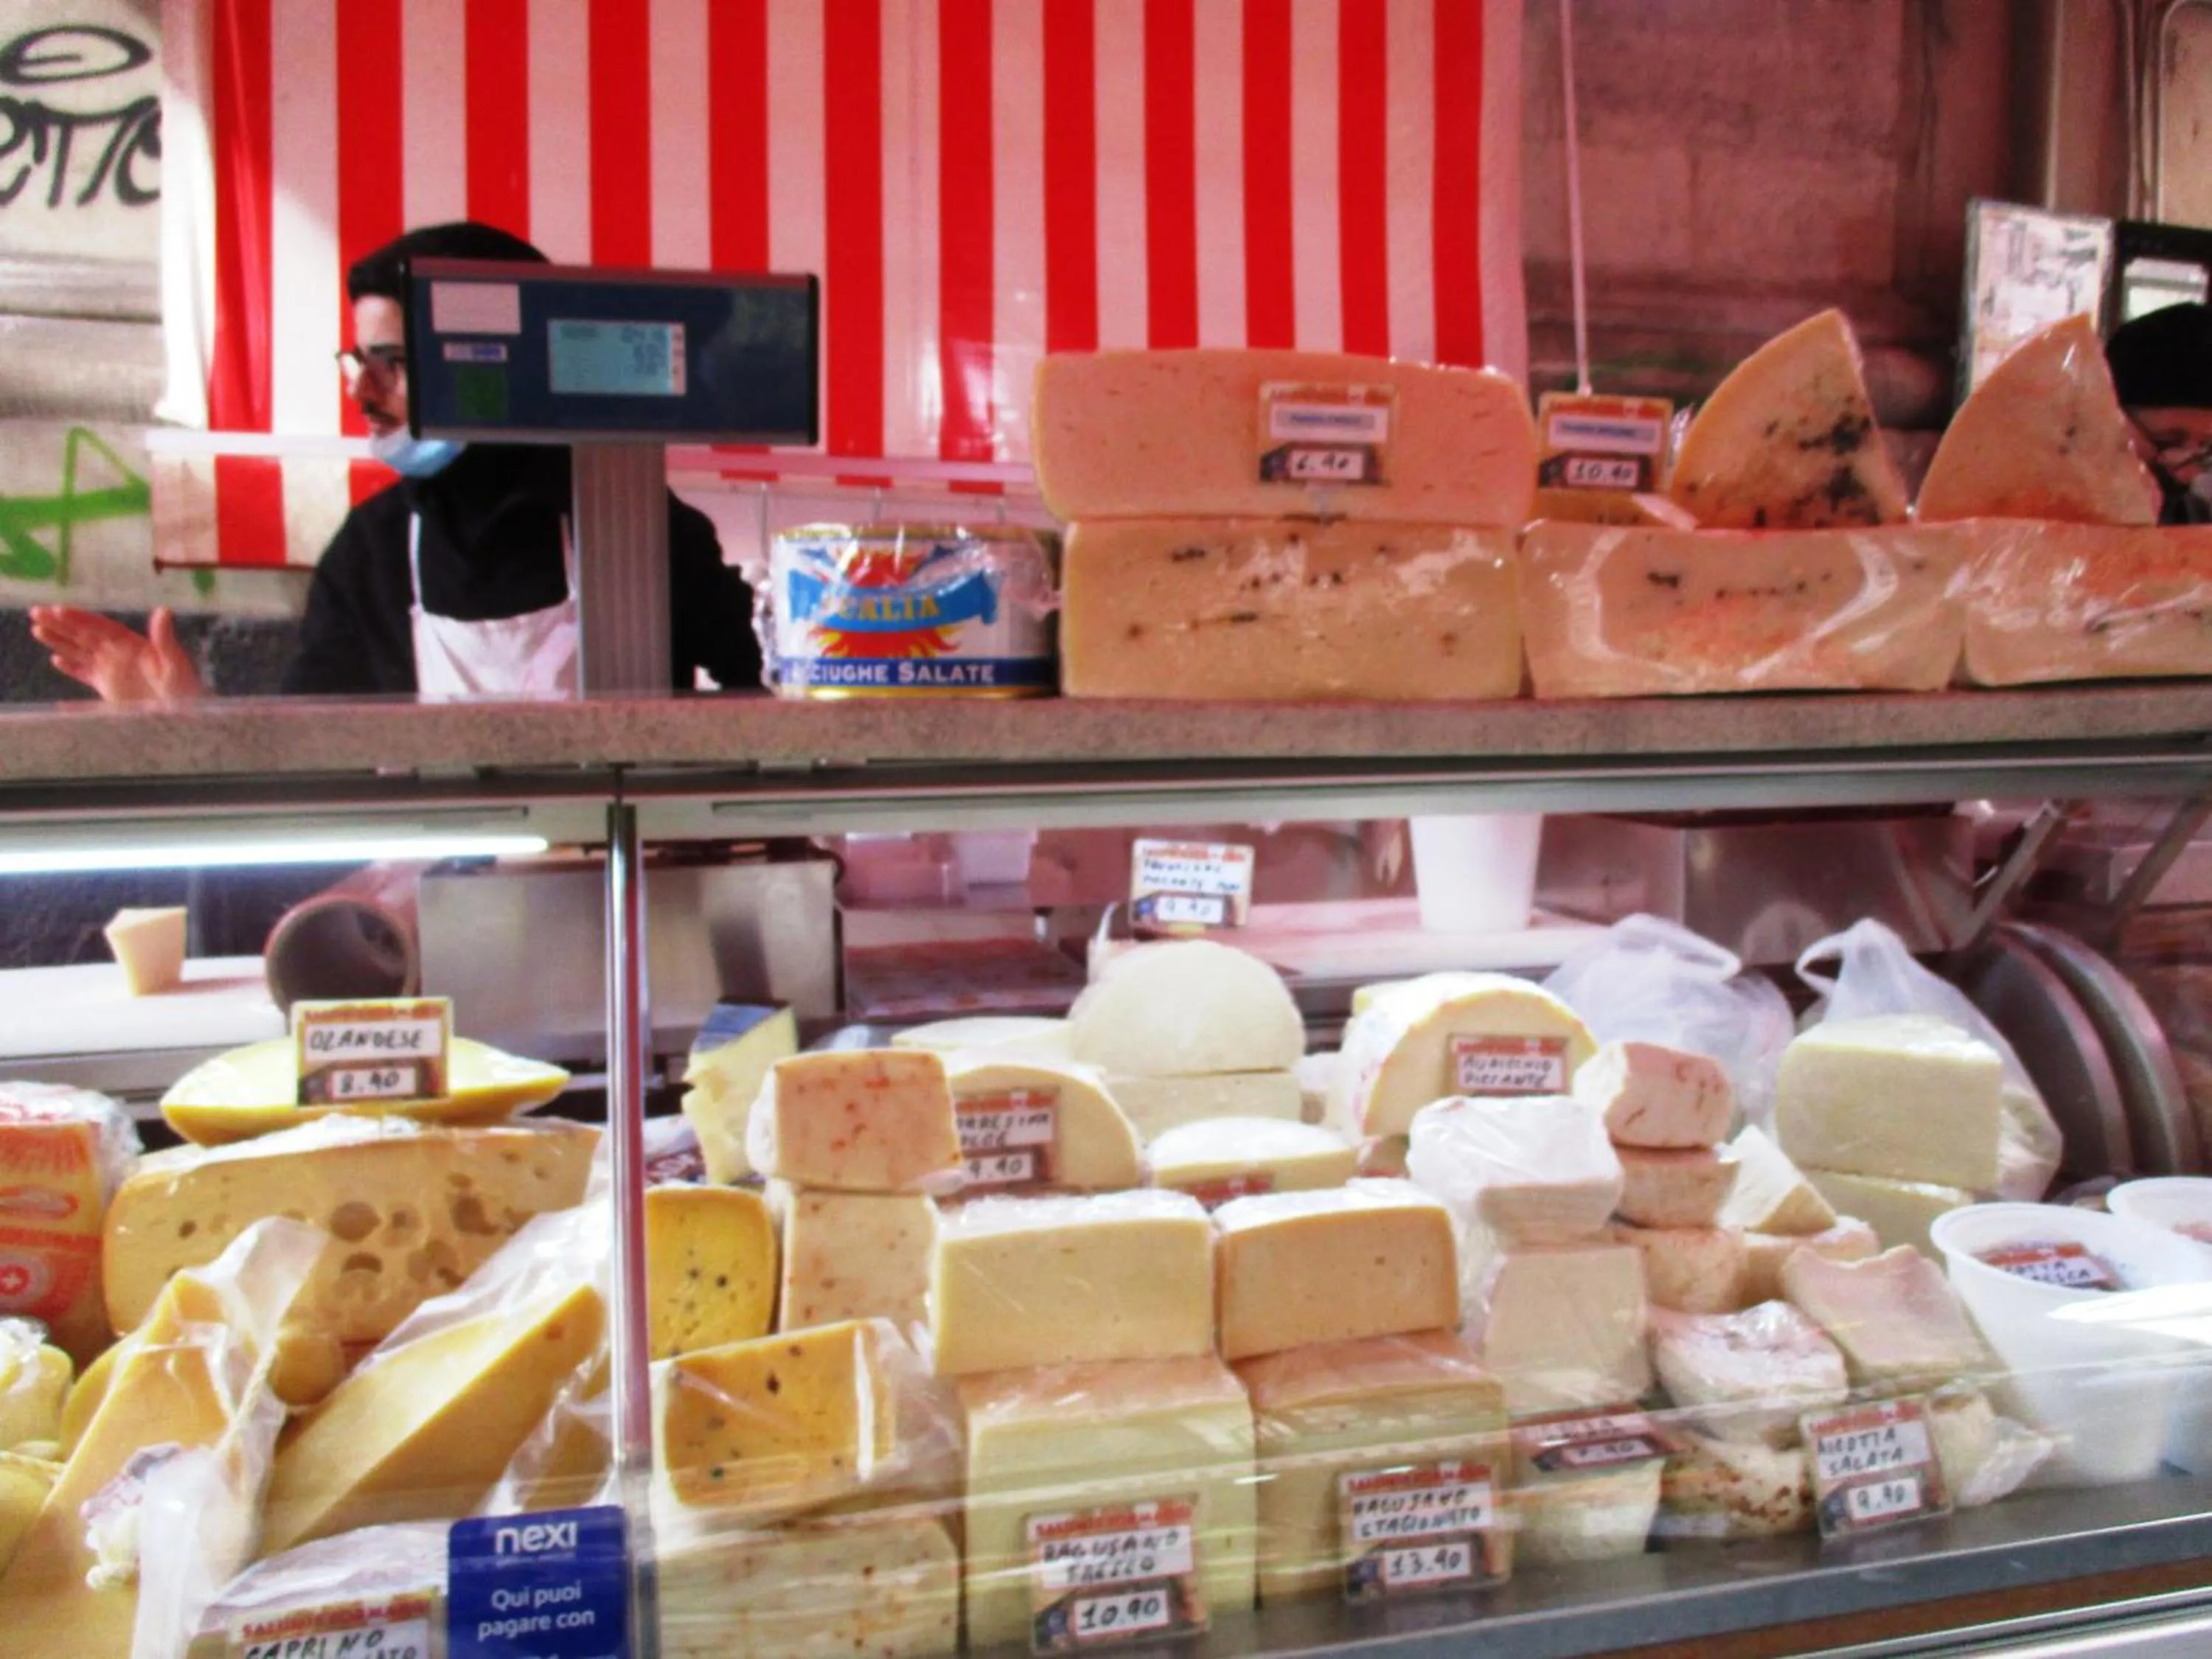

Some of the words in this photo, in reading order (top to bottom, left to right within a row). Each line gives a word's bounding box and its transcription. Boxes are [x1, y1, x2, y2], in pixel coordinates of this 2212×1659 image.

[790, 663, 889, 684] ACIUGHE
[897, 661, 995, 684] SALATE
[495, 1521, 578, 1554] nexi
[491, 1586, 530, 1612] Qui
[533, 1579, 582, 1609] puoi
[477, 1614, 552, 1643] pagare
[555, 1610, 596, 1629] con
